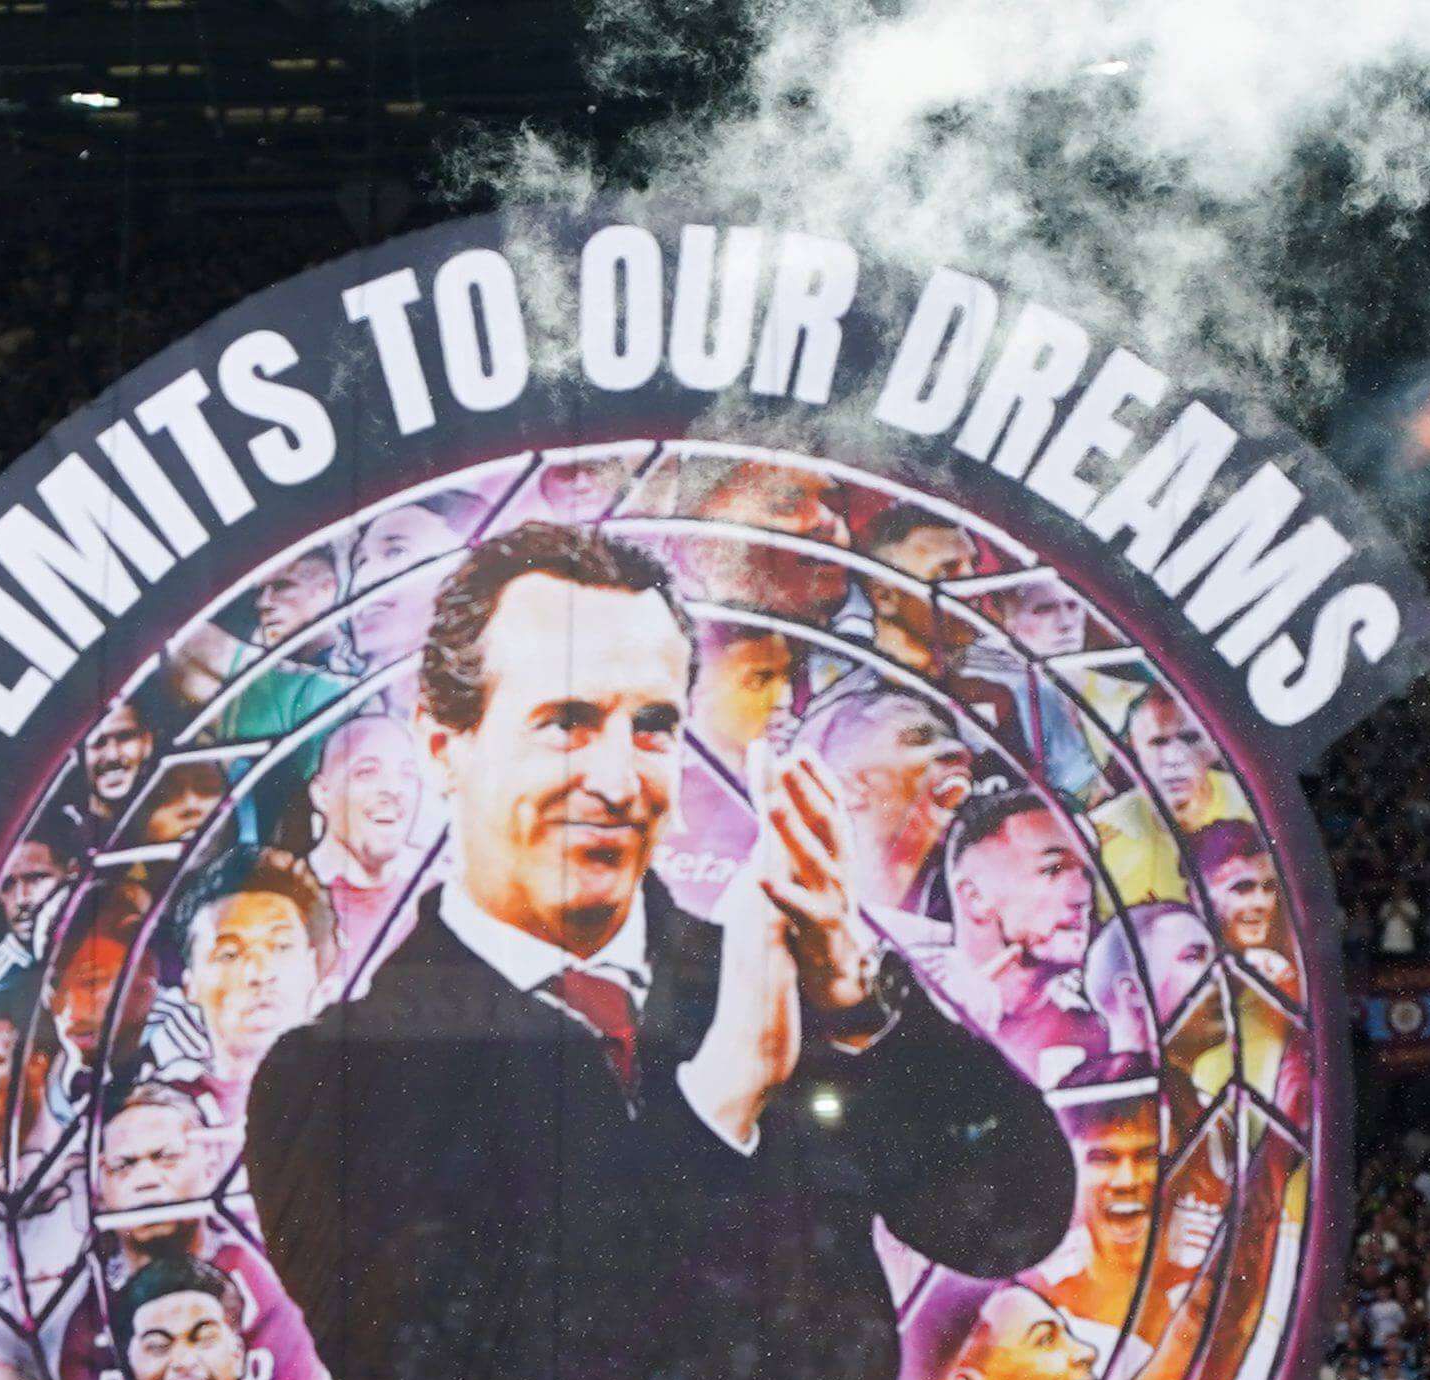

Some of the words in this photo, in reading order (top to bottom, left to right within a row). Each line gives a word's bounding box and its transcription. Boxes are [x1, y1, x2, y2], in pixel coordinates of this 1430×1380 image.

[342, 248, 530, 436] TO
[580, 224, 859, 405] OUR
[874, 266, 1401, 728] DREAMS
